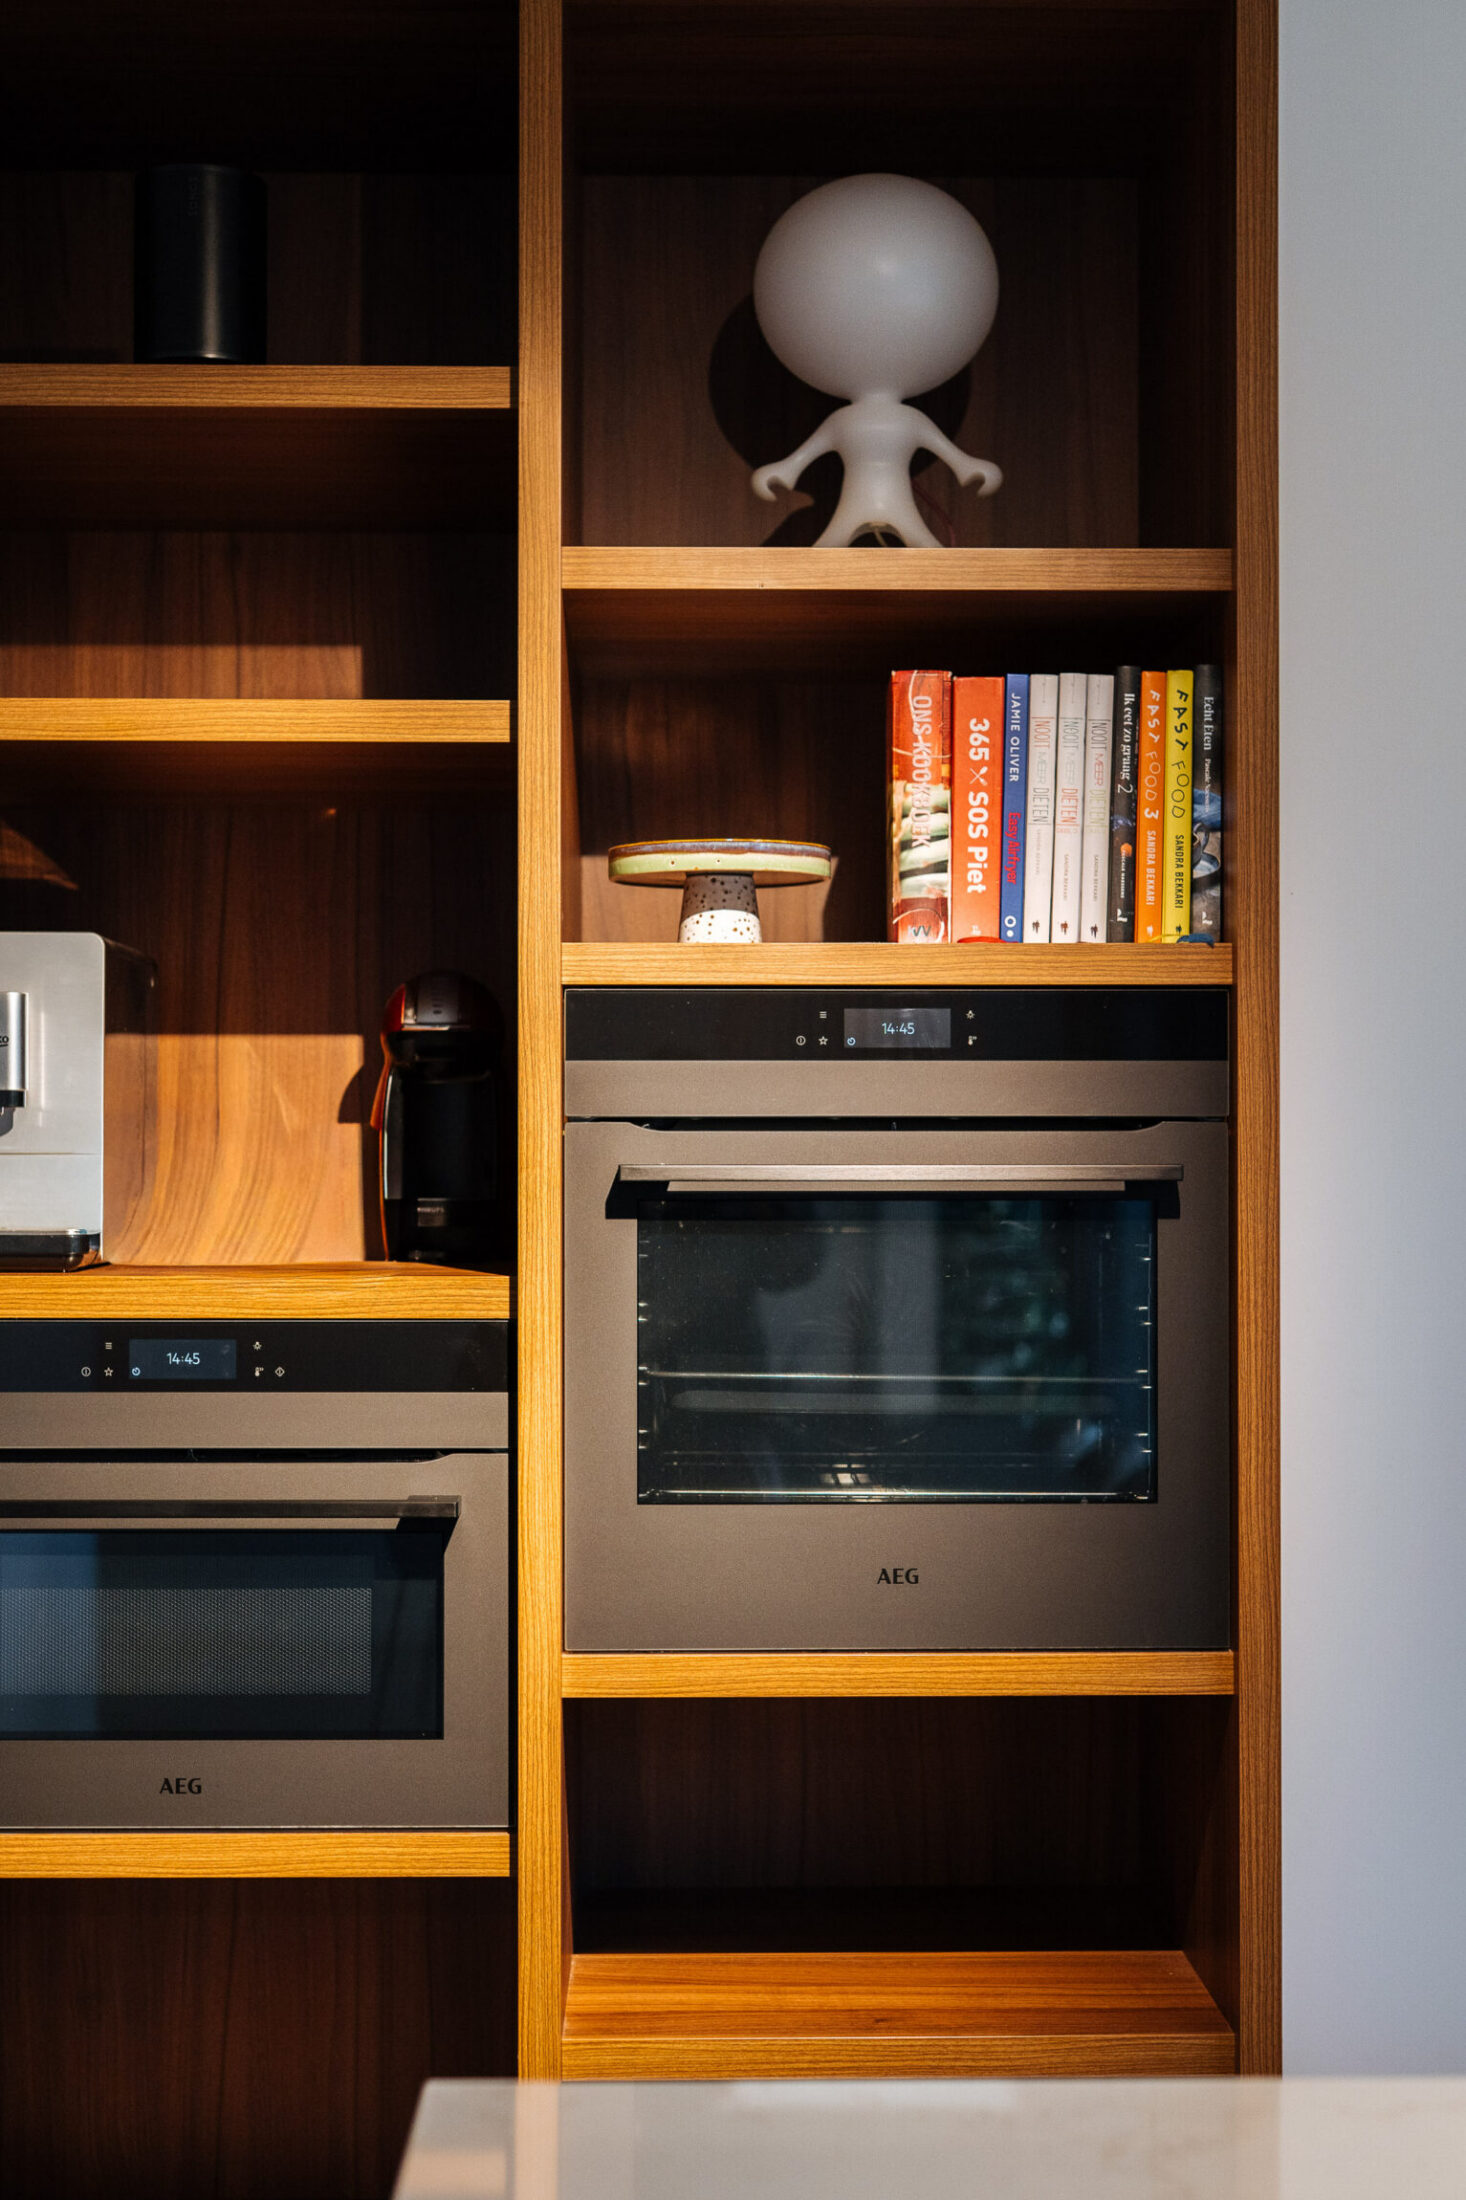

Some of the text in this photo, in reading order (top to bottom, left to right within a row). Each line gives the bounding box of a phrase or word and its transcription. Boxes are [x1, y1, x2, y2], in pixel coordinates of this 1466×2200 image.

[1009, 693, 1021, 782] JAMIE OLIVER
[1062, 721, 1079, 750] NOOIT
[1090, 722, 1107, 751] NOOIT
[1117, 693, 1135, 794] Ik eet zo graag 2
[1144, 689, 1160, 819] FAST FOOD 3
[1171, 689, 1189, 818] FAST FOOD
[1203, 697, 1214, 751] Echt Eten
[911, 696, 932, 848] ONS KOOKBOEK
[1032, 720, 1051, 823] NOOIT MEER DIETEN
[1094, 753, 1104, 786] MEER
[967, 718, 990, 894] 365 SOS Piet
[1061, 788, 1078, 823] DIETEN
[1089, 790, 1106, 824] DIETEN
[1004, 812, 1020, 885] Easy Airfryer
[1145, 830, 1156, 906] SANDRA BEKKARI
[1174, 834, 1184, 909] SANDRA BEKKARI
[881, 1022, 915, 1035] 14:45
[166, 1352, 200, 1365] 14:45
[877, 1568, 919, 1585] AEG
[159, 1777, 202, 1795] AEG
